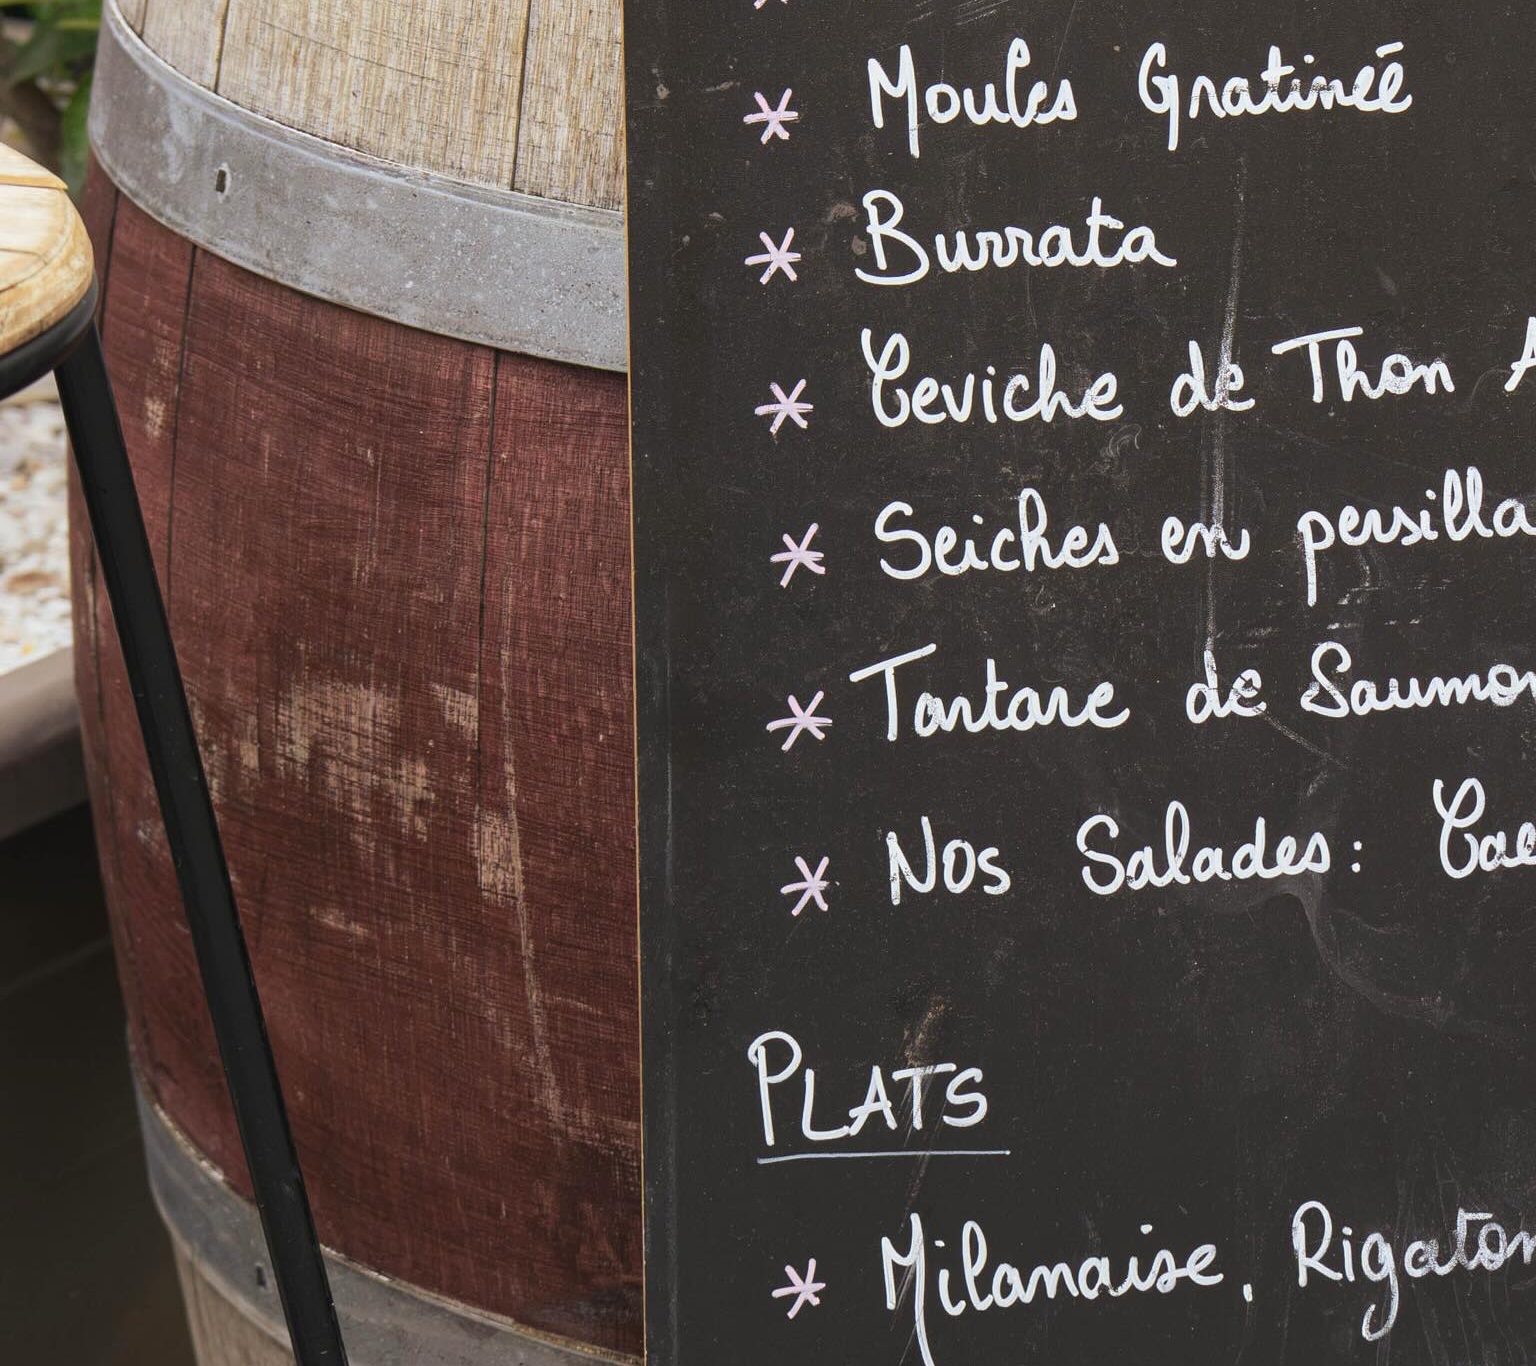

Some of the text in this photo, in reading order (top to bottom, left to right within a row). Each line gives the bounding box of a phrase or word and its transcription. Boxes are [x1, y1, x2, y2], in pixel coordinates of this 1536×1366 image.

[868, 38, 1077, 158] Moules
[855, 190, 1177, 285] Burrata
[861, 328, 1123, 427] Ceviche
[1170, 339, 1255, 417] de
[1272, 326, 1455, 403] Thon
[875, 488, 1119, 580] Seiches
[1161, 505, 1250, 564] en
[849, 643, 1130, 741] Tartare
[1186, 650, 1267, 724] de
[886, 816, 1011, 905] Nos
[748, 1031, 987, 1146] PLATS
